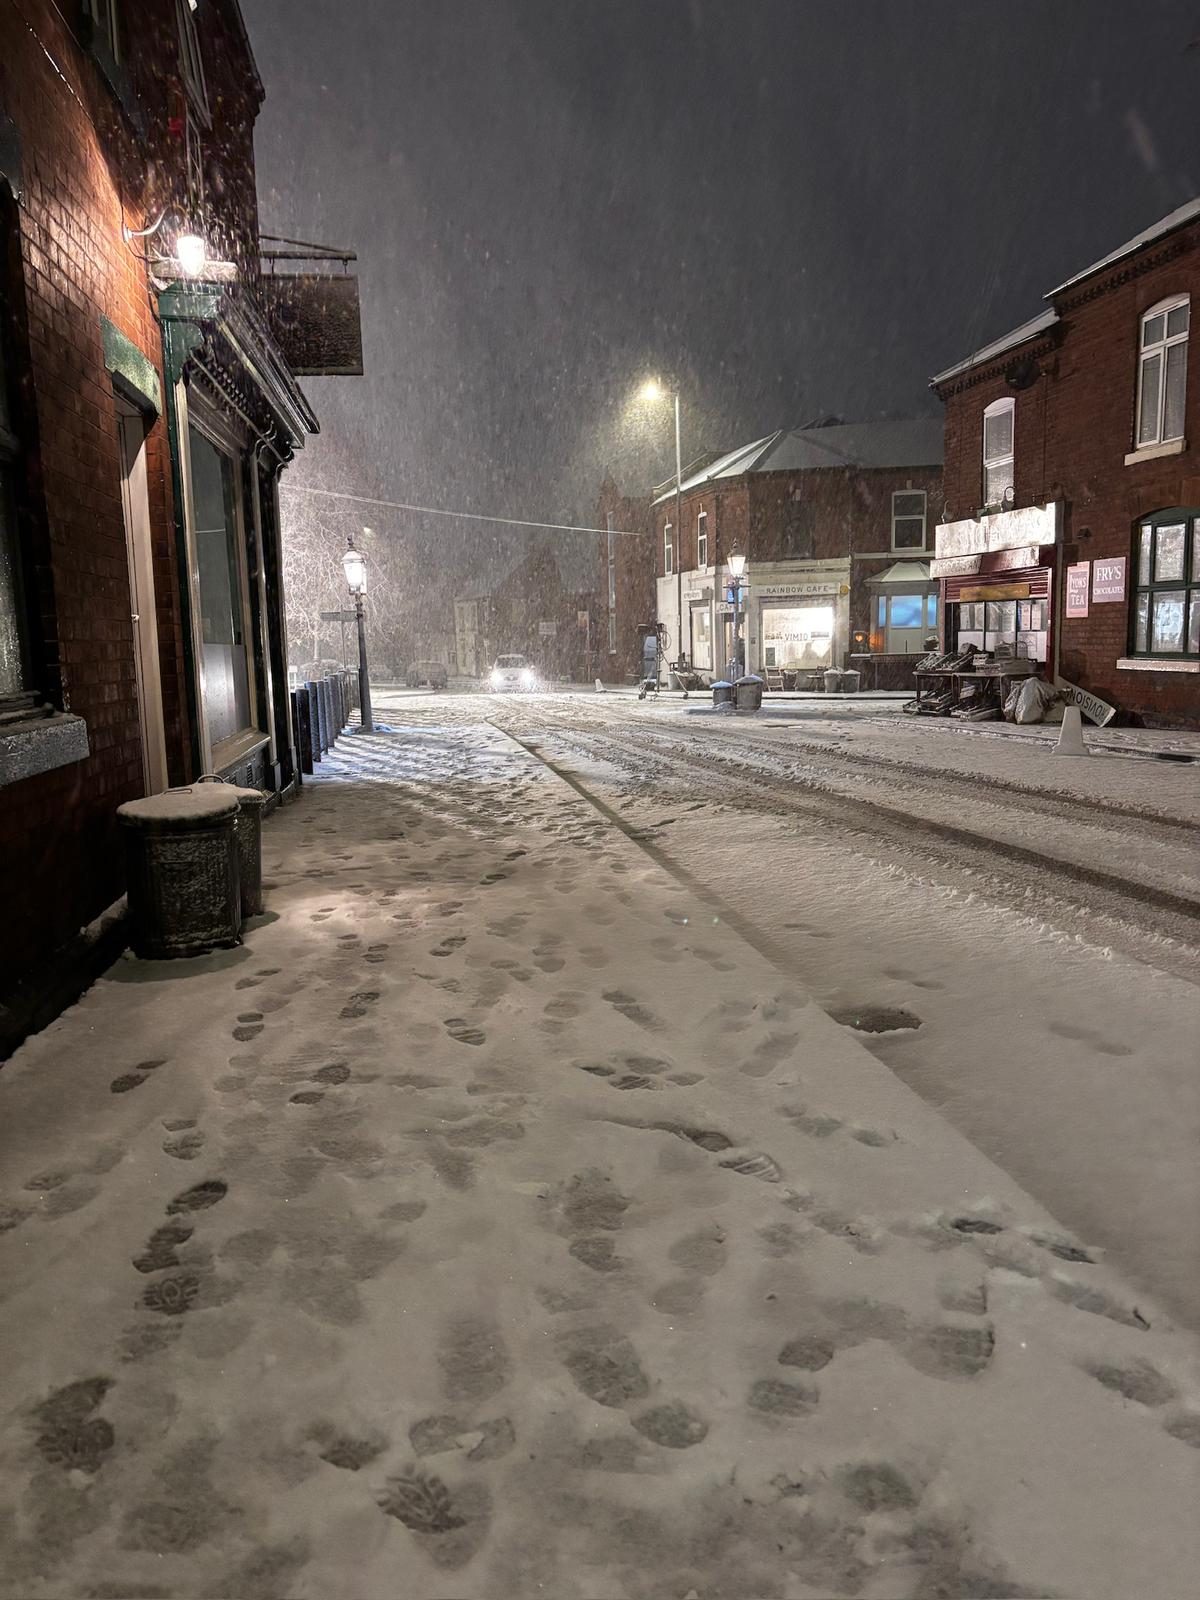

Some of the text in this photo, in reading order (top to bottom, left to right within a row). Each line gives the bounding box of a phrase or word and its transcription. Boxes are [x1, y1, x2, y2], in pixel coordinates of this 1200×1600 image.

[1096, 566, 1121, 581] FRY'S
[766, 586, 804, 594] RAINBOW
[1070, 594, 1085, 605] TEA
